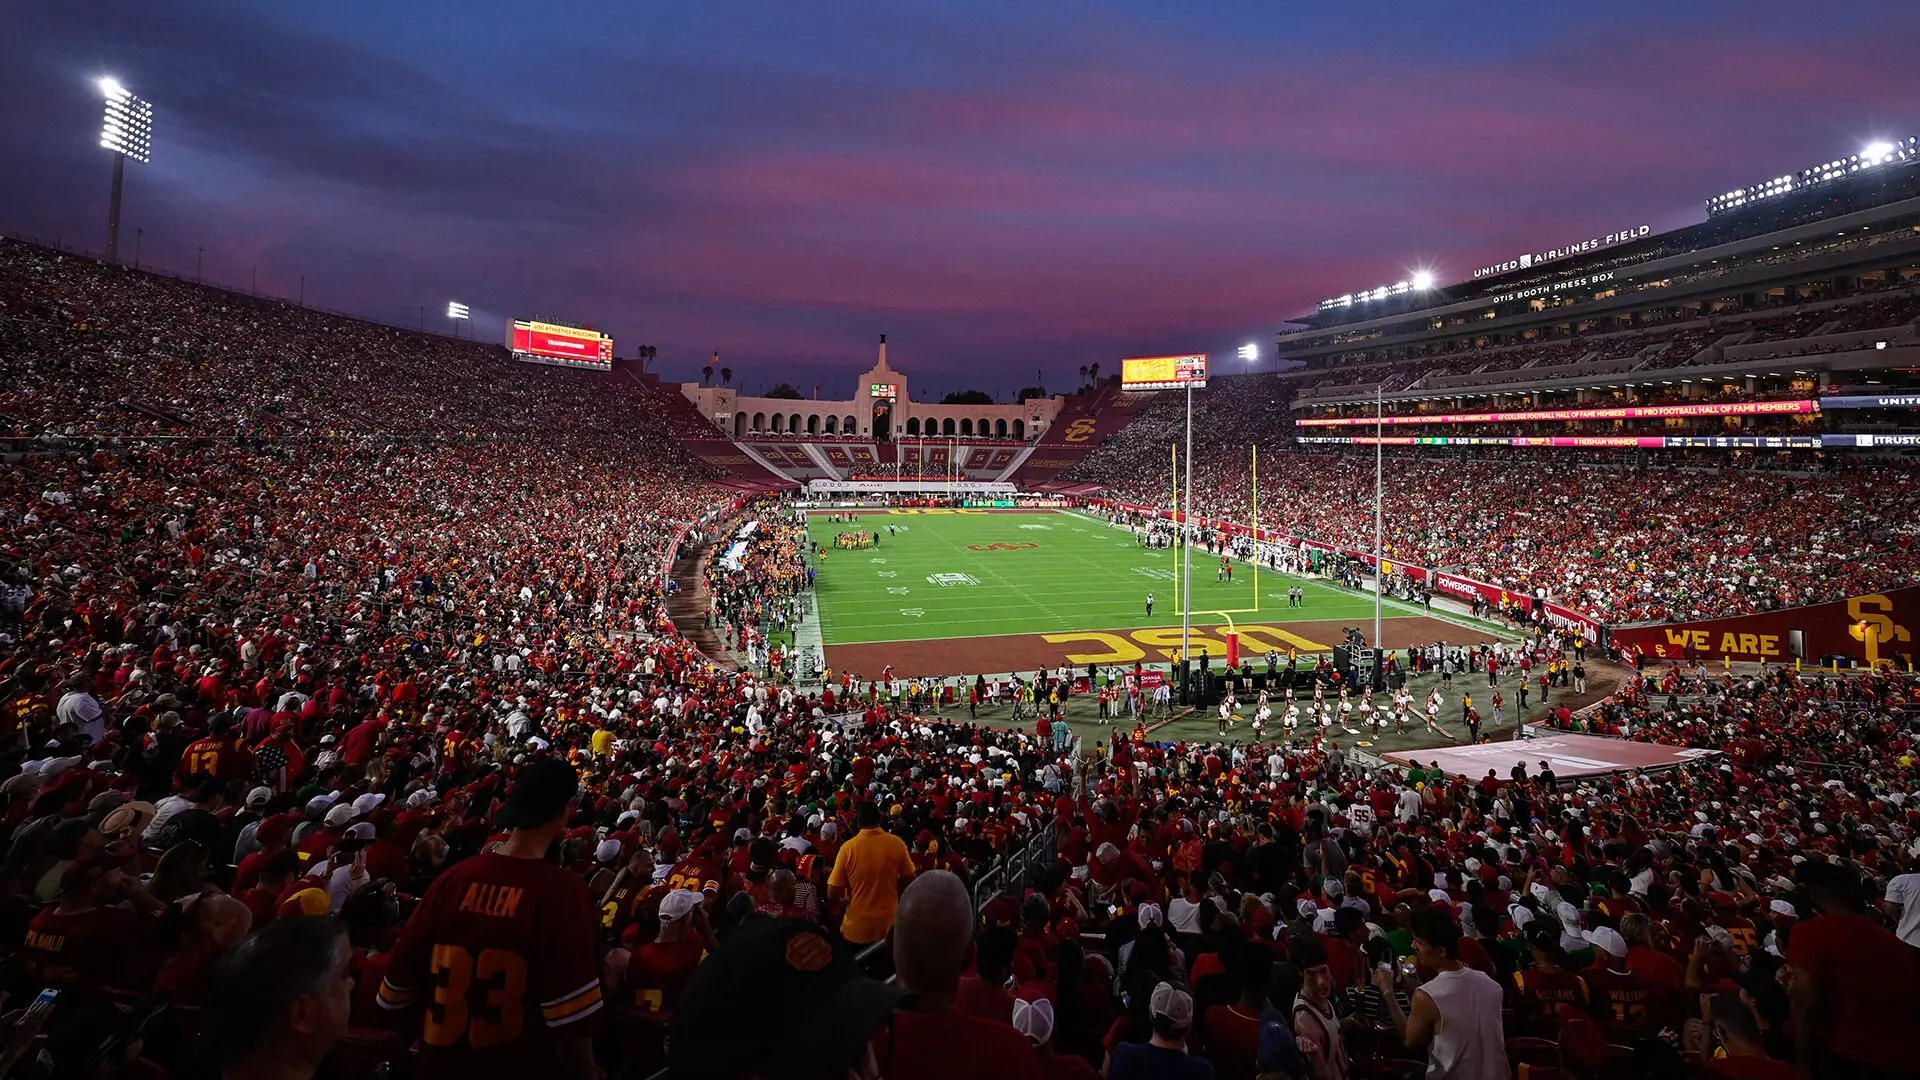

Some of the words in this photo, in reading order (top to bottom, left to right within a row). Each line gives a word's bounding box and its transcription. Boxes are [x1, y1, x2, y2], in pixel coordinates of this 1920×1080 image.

[1474, 260, 1518, 278] UNITED
[1534, 238, 1599, 263] AIRLINES
[1605, 225, 1650, 245] FIELD
[1493, 293, 1514, 304] OTIS
[1517, 286, 1550, 299] BOOTH
[1554, 278, 1587, 291] PRESS
[1592, 272, 1615, 283] BOX
[1644, 408, 1658, 416] PRO
[1659, 407, 1698, 415] FOOTBALL
[1757, 403, 1801, 411] MEMBERS
[1438, 576, 1477, 594] POWERADE
[1040, 624, 1332, 665] USC
[1655, 644, 1666, 658] SC
[1665, 628, 1710, 650] WE
[1720, 632, 1780, 656] ARE
[444, 738, 455, 758] 24
[1734, 746, 1745, 757] 54
[190, 752, 220, 776] 13
[1226, 798, 1243, 814] 24
[1354, 810, 1369, 822] 55
[1361, 872, 1374, 894] 6
[459, 882, 524, 918] ALLEN
[424, 943, 528, 1050] 33
